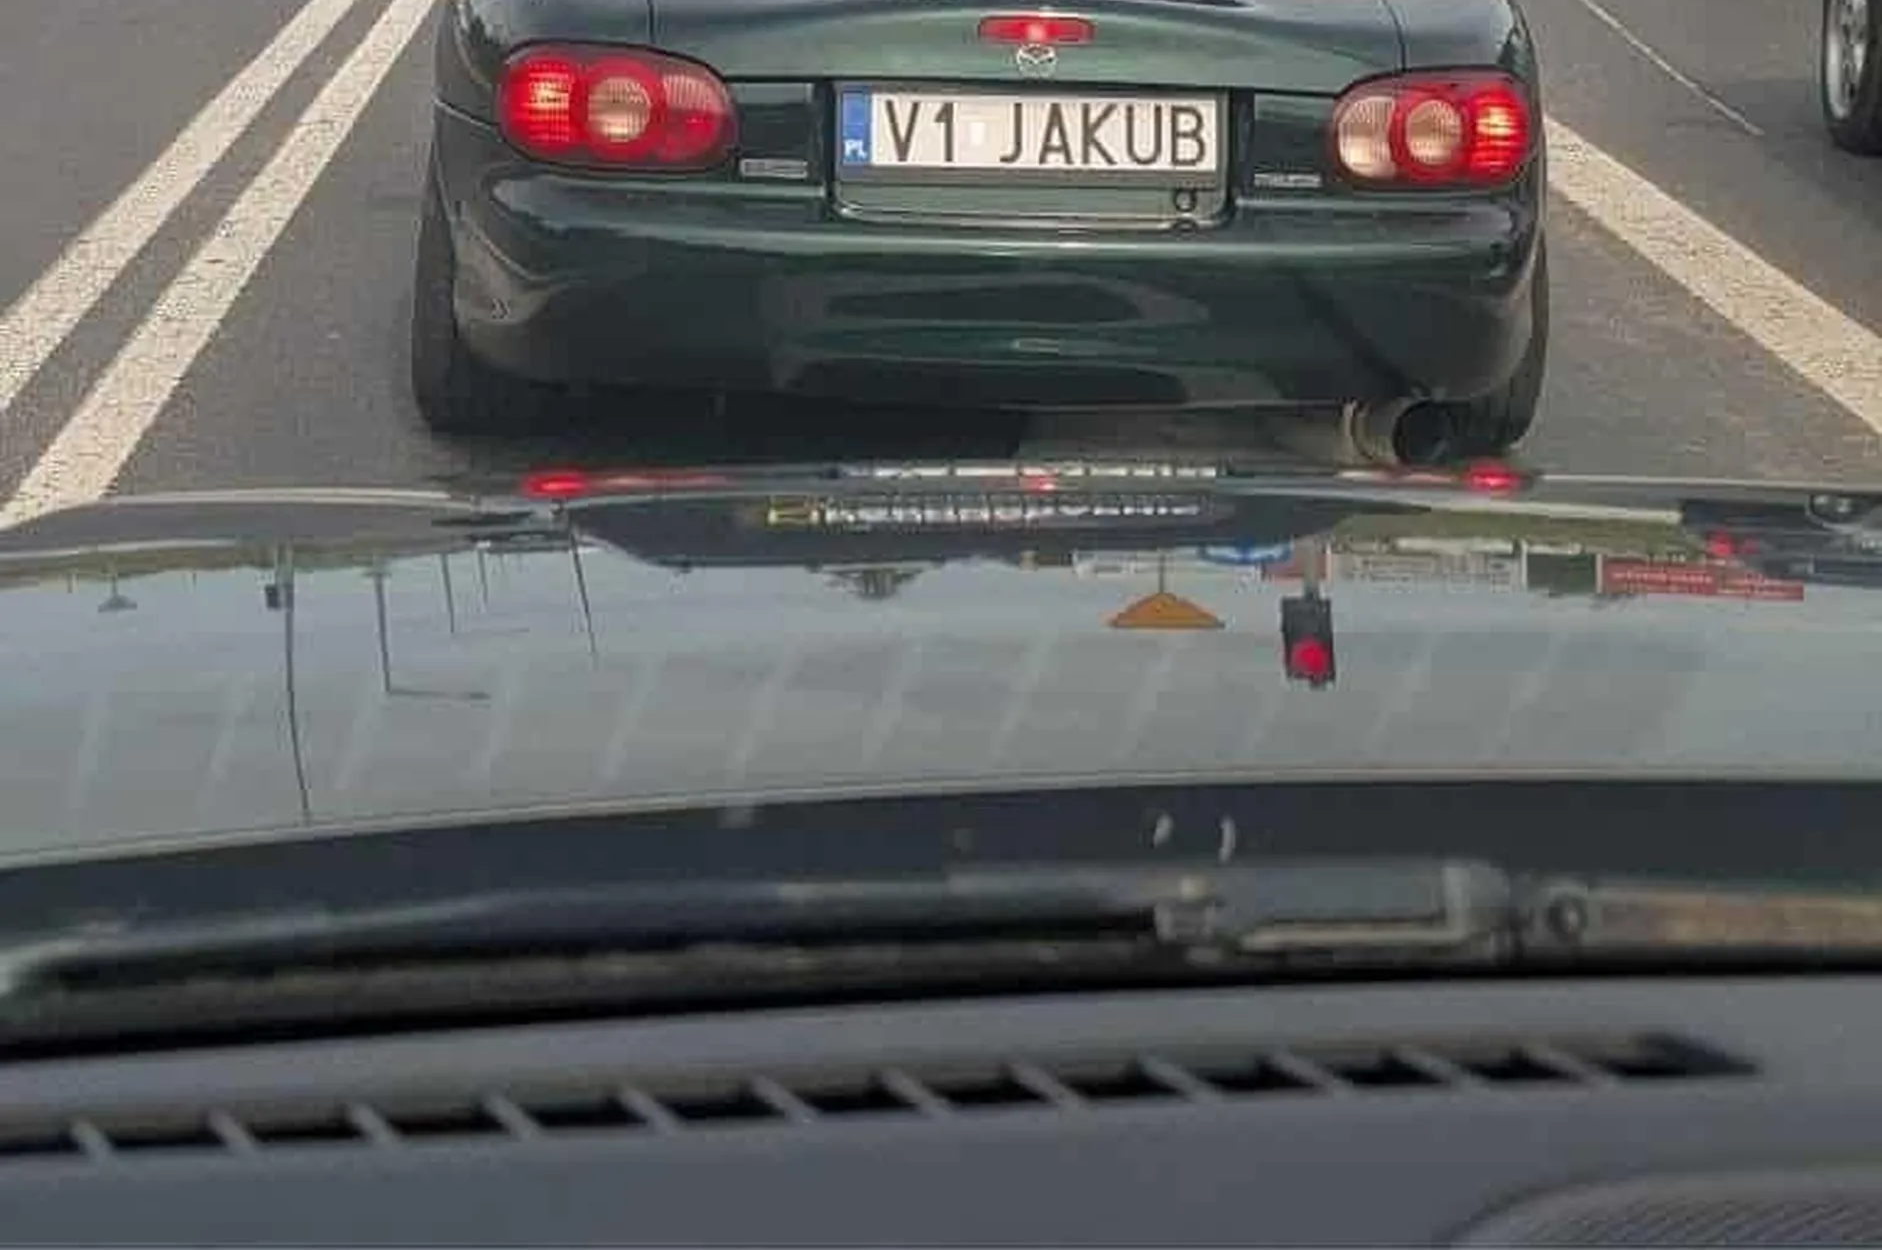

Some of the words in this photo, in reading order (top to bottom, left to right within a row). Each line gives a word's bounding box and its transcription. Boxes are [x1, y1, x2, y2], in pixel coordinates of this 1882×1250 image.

[844, 139, 868, 159] PL
[882, 98, 956, 164] V1
[998, 101, 1207, 167] JAKUB
